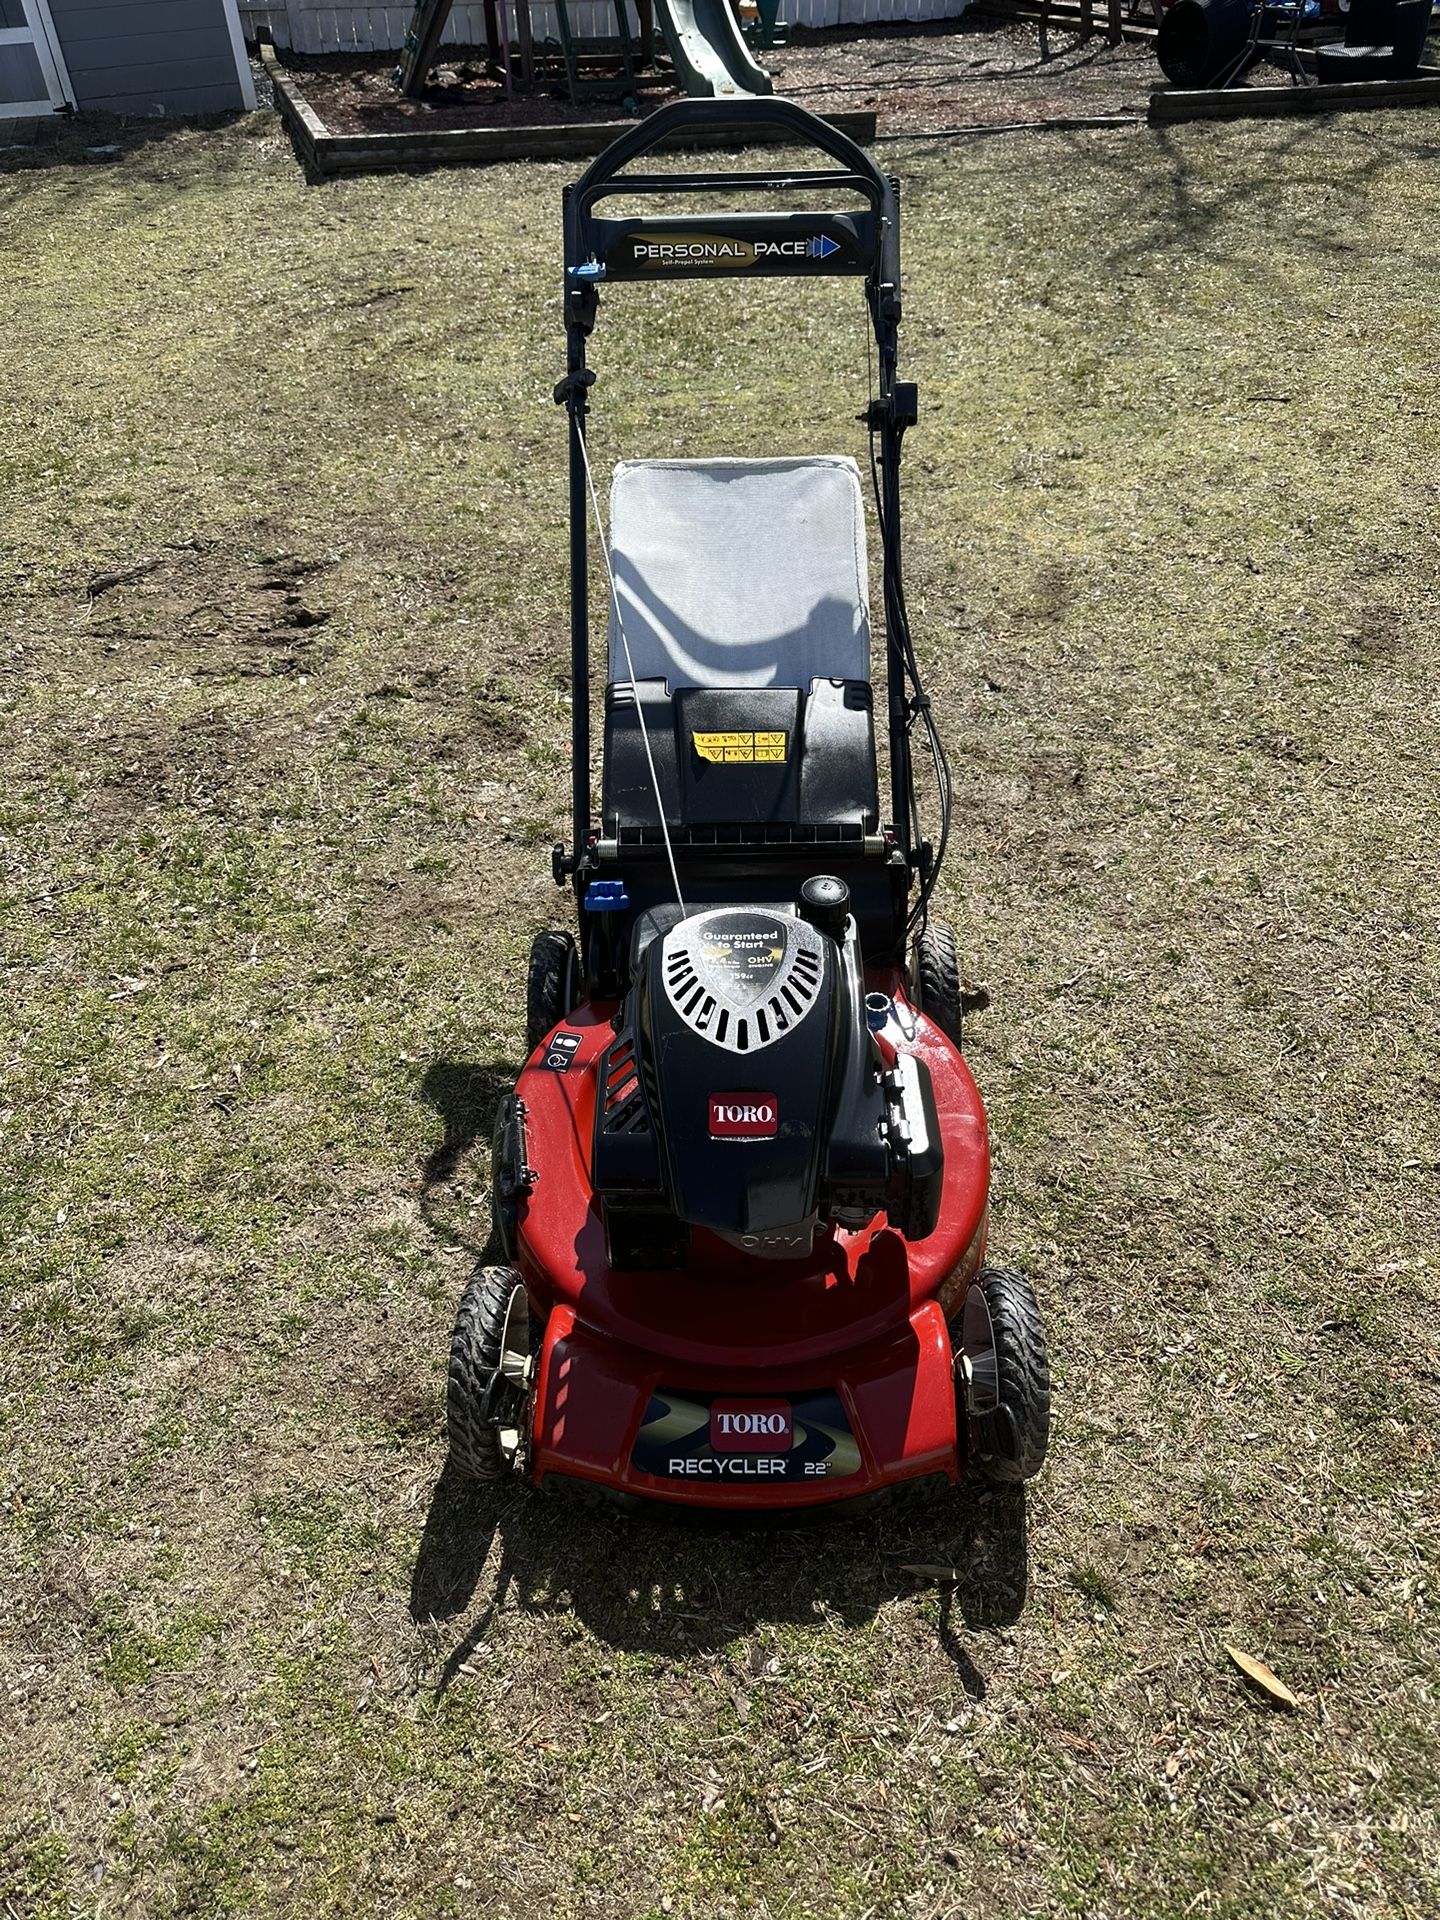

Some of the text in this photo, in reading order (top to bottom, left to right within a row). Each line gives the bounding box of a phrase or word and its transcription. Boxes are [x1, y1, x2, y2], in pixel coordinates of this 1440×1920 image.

[633, 241, 805, 258] PERSONAL PACE
[703, 931, 778, 941] Guaranteed
[718, 941, 764, 949] to Start
[747, 956, 774, 964] OHV
[713, 1105, 773, 1122] TORO
[717, 1413, 786, 1434] TORO
[669, 1458, 786, 1475] RECYCLER
